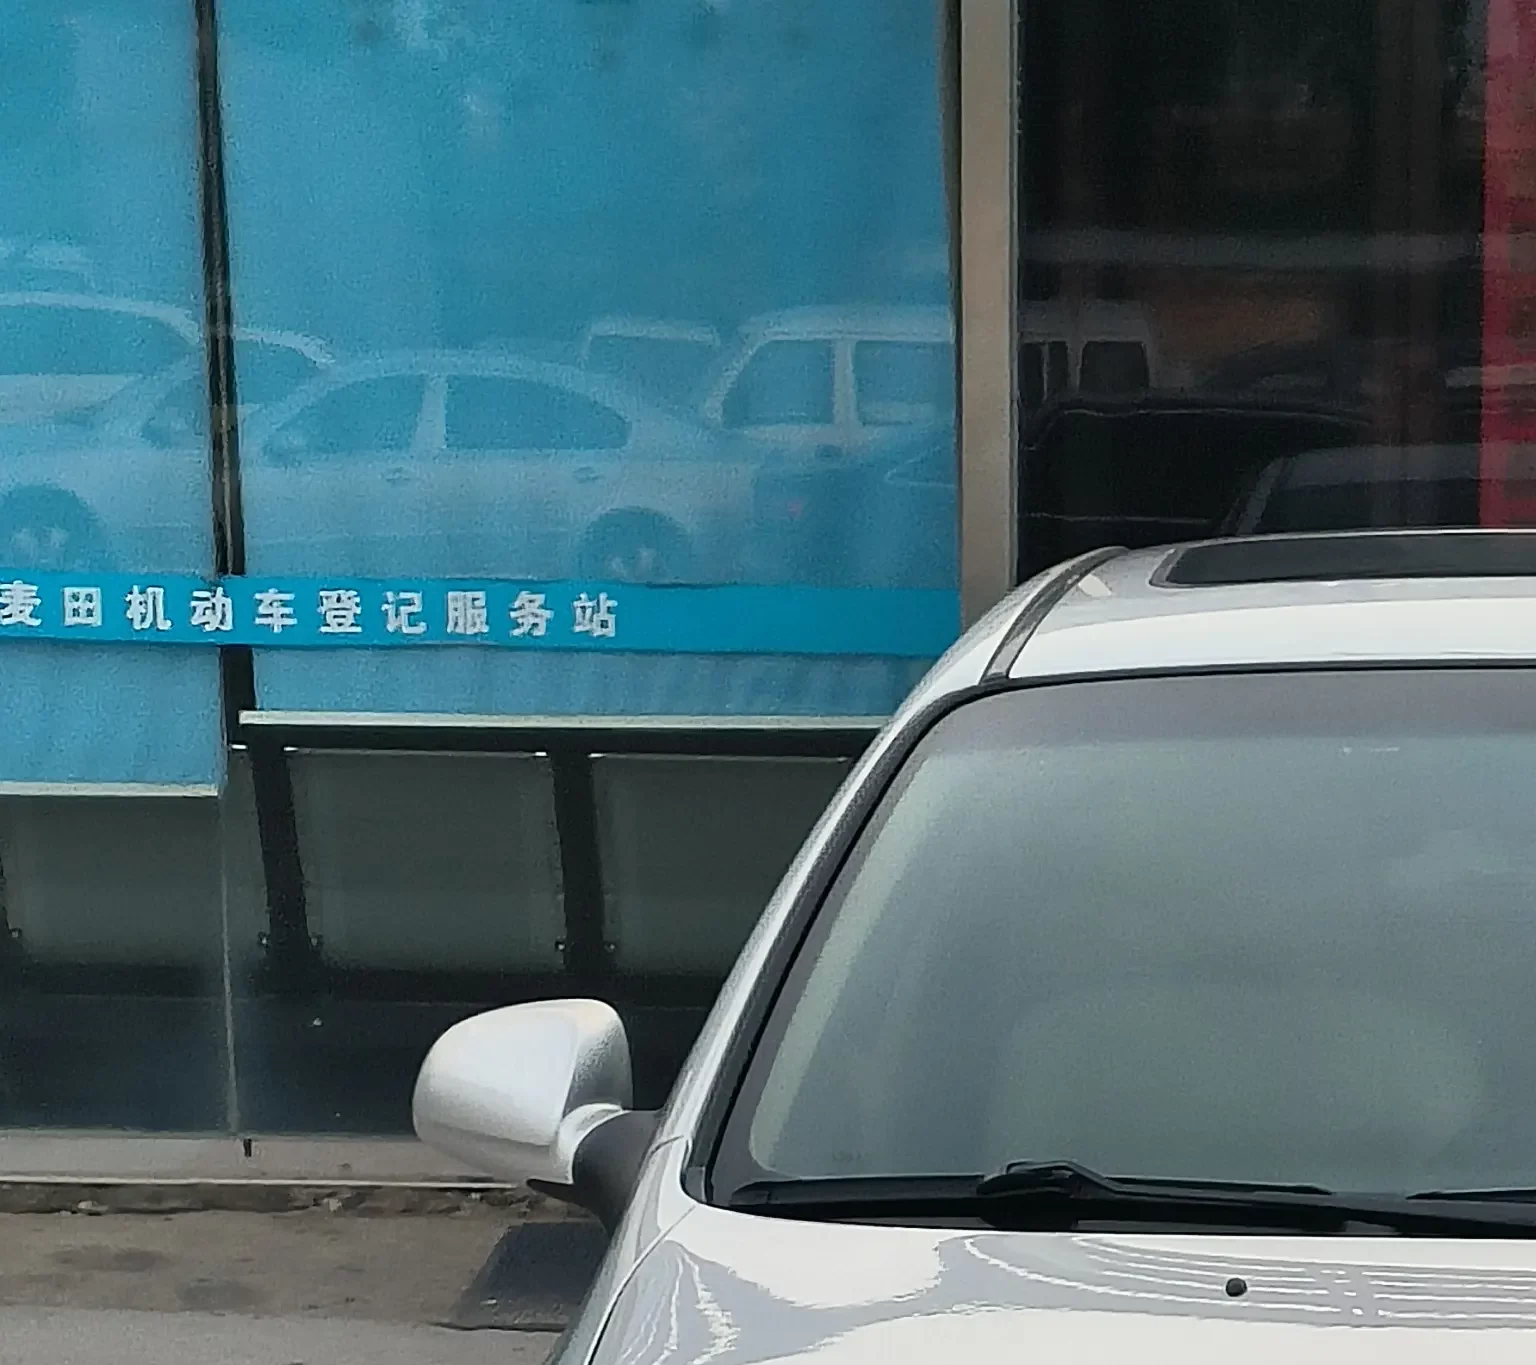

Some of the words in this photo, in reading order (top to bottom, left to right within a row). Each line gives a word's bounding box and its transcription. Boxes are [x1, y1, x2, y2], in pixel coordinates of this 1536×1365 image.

[0, 580, 617, 638] 麦田机动车登记服务站
